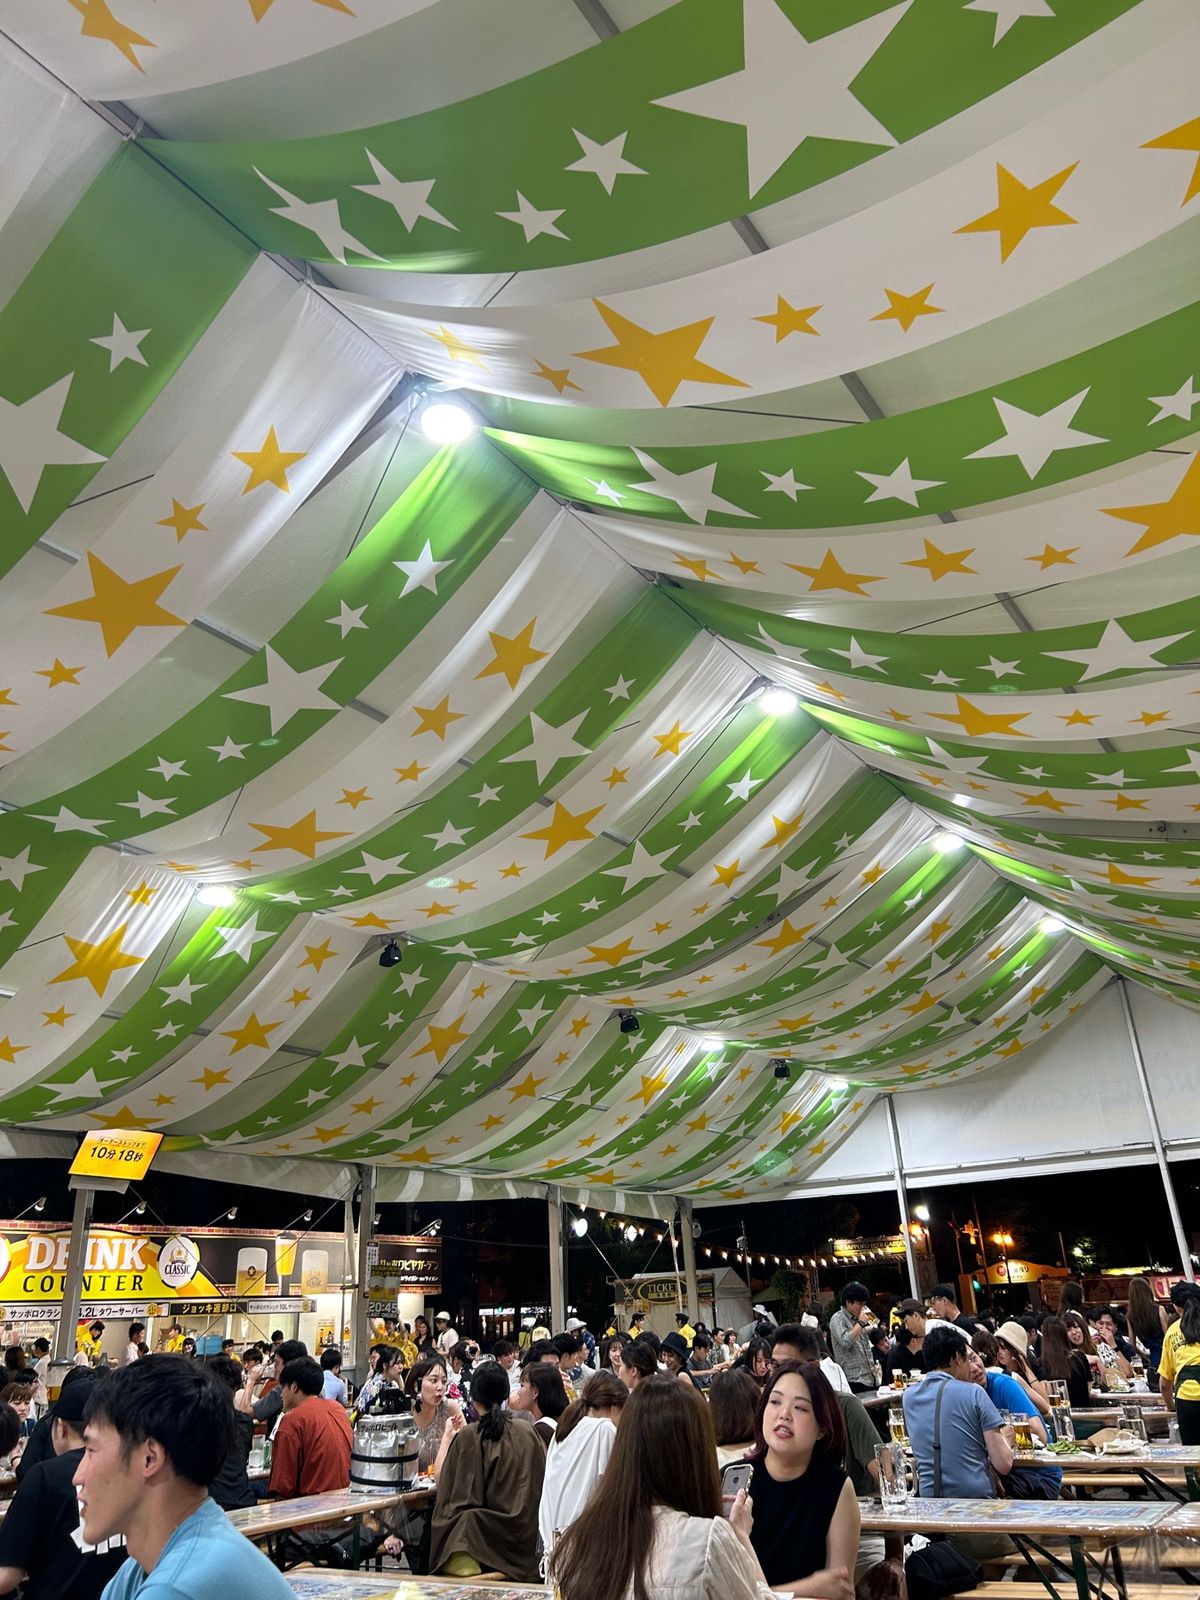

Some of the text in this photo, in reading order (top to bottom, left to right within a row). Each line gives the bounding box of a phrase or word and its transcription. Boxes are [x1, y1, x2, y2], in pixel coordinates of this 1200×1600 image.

[165, 1264, 191, 1275] CLASSIC
[23, 1275, 143, 1293] CONTER
[10, 1310, 61, 1319] サッポロクラシ
[99, 1307, 145, 1317] タワーサーバー
[368, 1302, 398, 1313] 20:45
